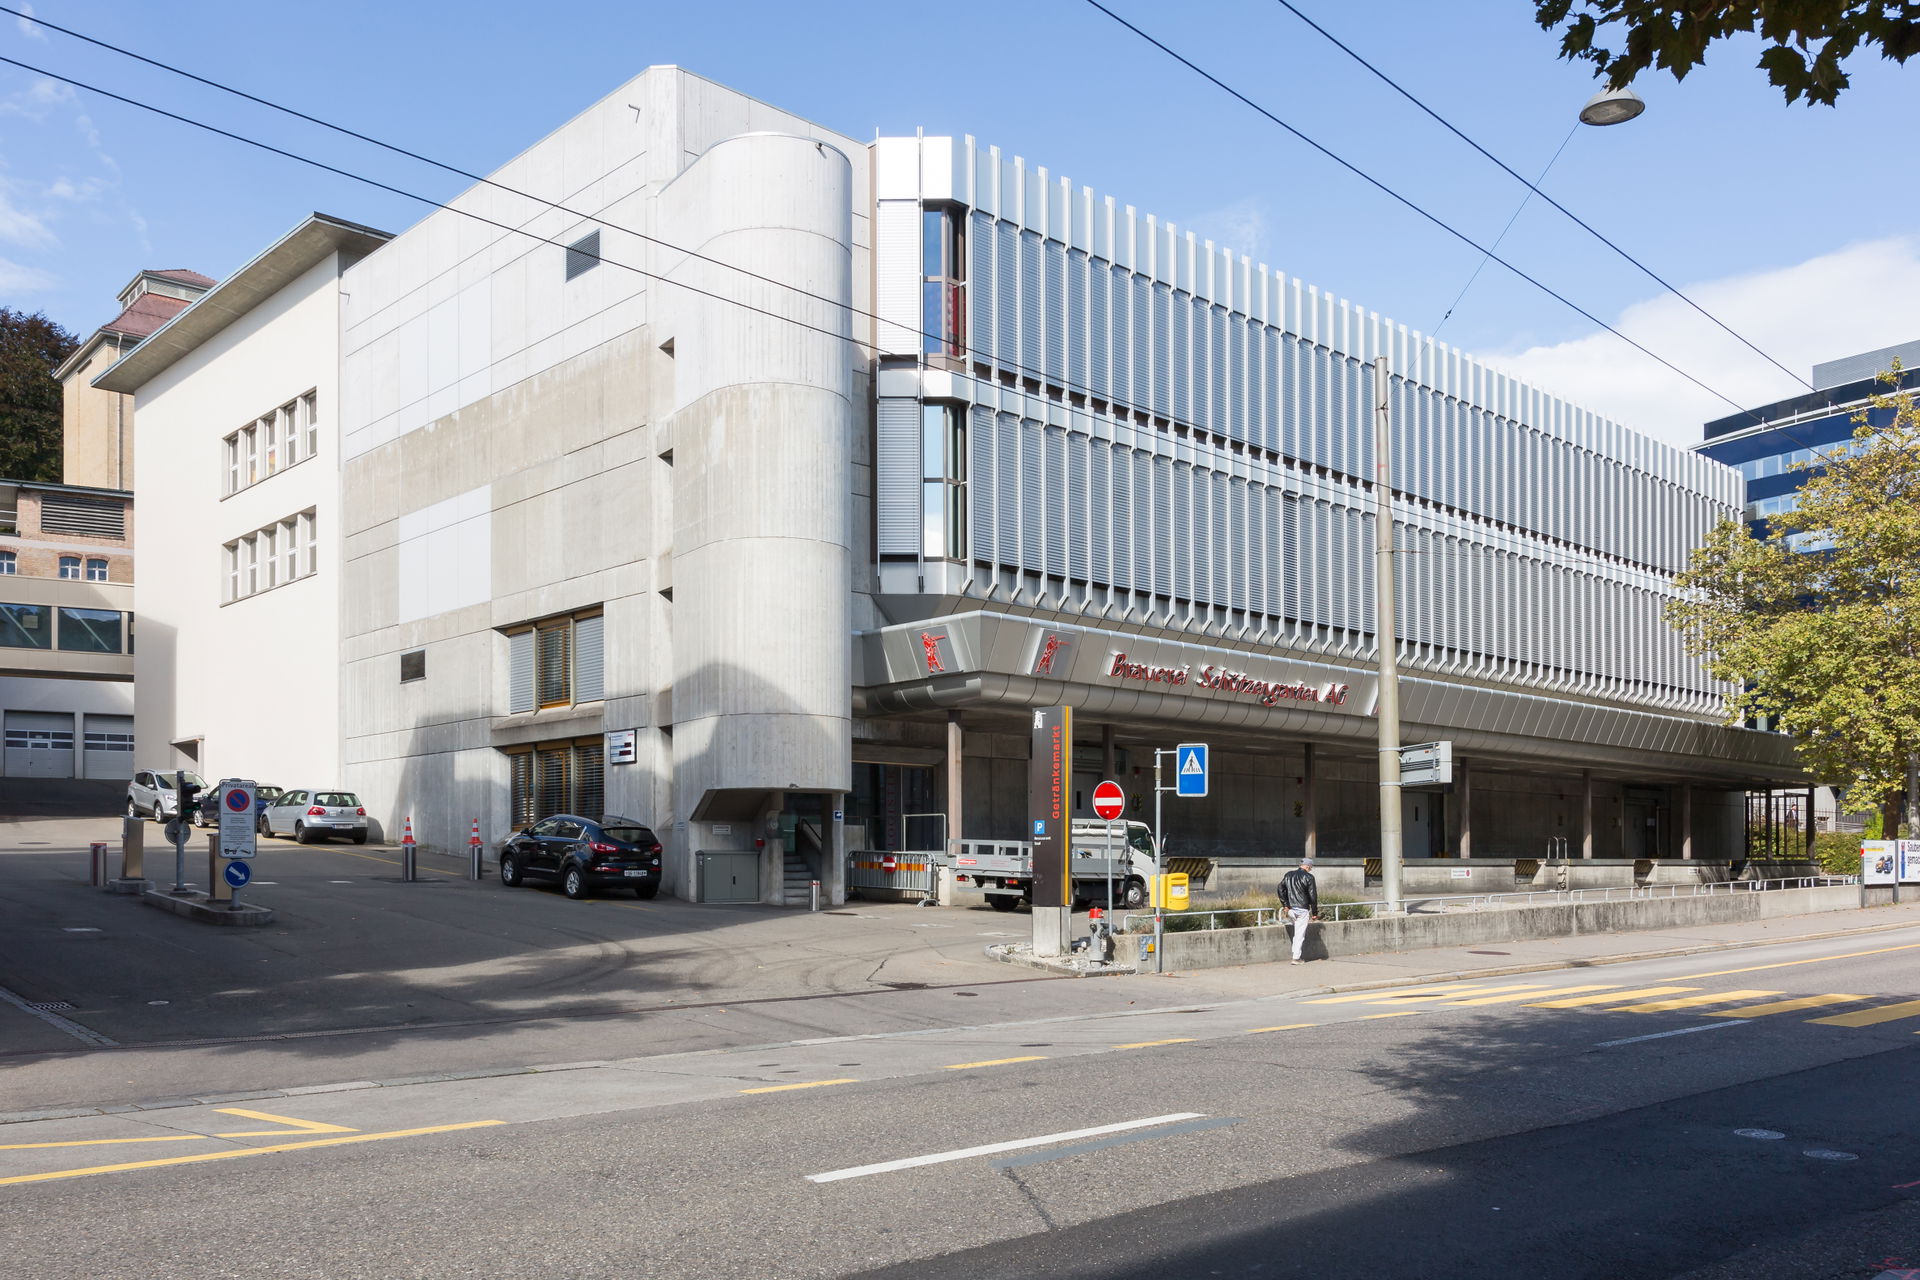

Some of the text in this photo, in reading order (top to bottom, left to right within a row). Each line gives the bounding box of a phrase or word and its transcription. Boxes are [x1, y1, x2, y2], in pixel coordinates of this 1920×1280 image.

[1109, 653, 1349, 706] Brauerei Schützengarten AG
[1051, 725, 1061, 820] Getränkemarkt
[1037, 822, 1043, 832] P
